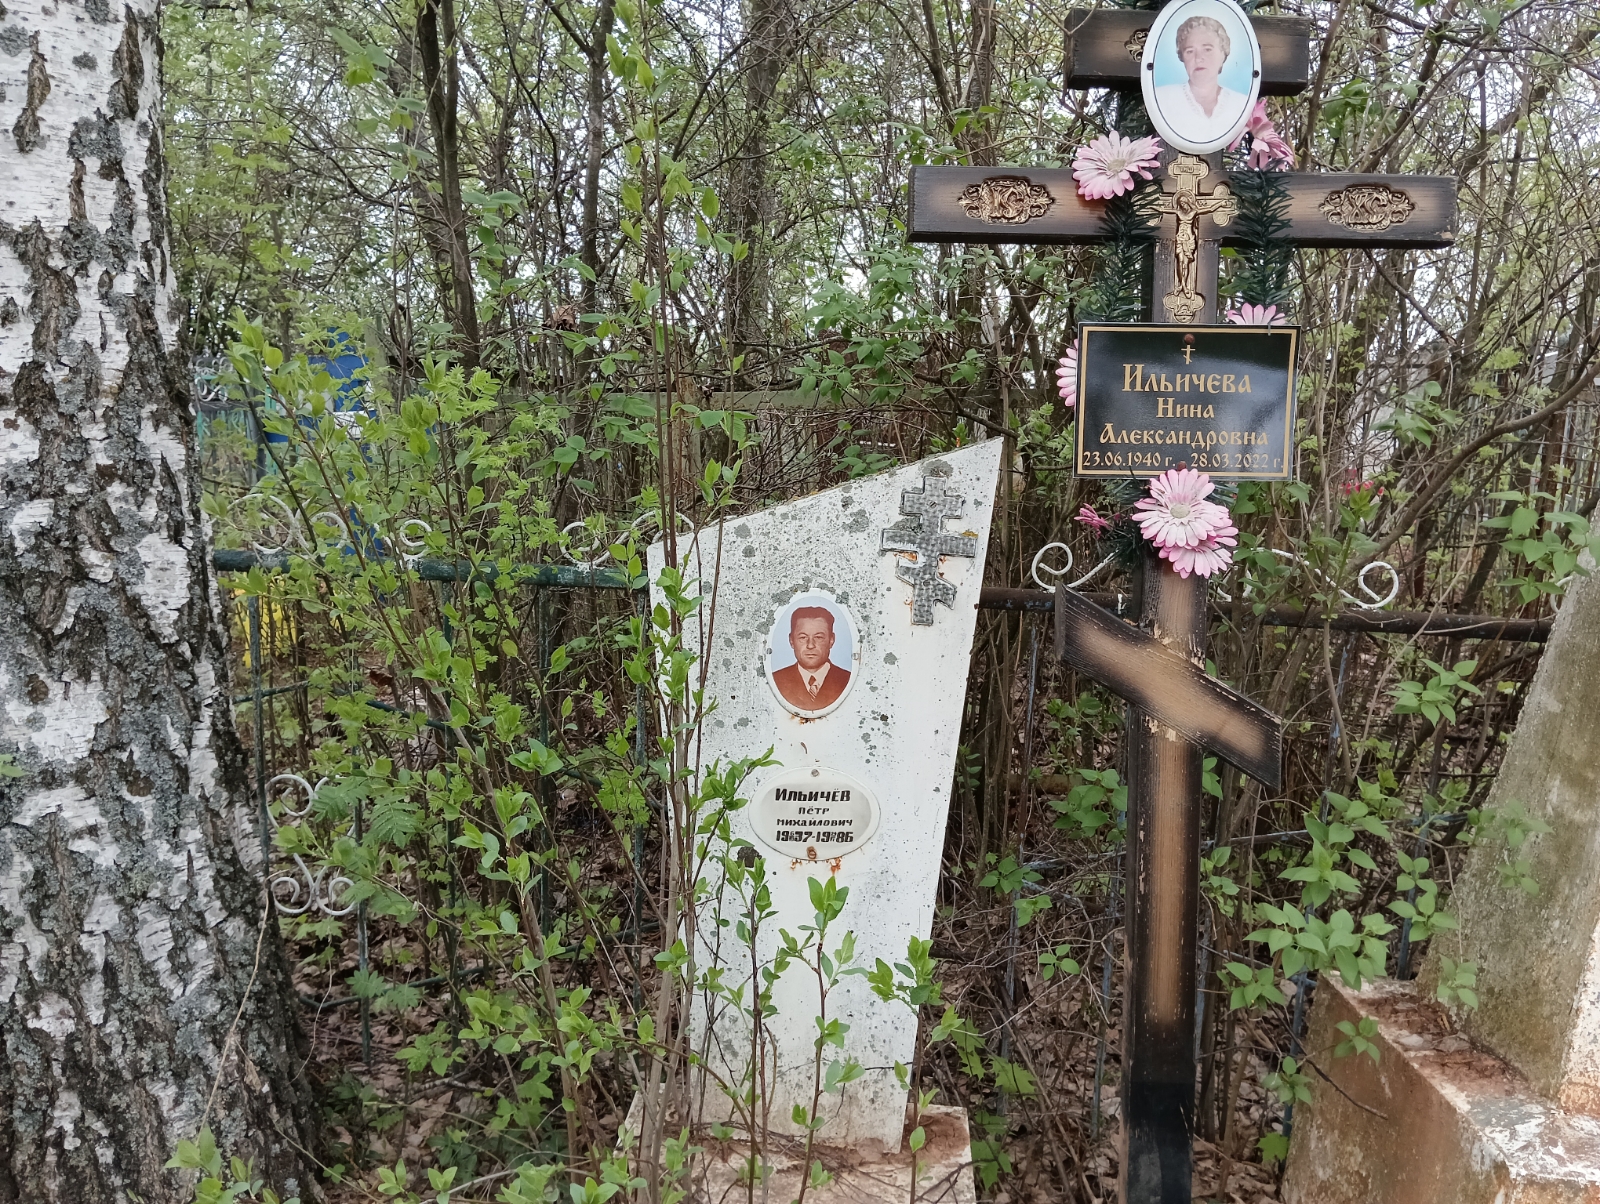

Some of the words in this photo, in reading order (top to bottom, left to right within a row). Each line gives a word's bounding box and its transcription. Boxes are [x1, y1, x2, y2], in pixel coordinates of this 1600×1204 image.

[1122, 363, 1252, 394] Ильичева
[1156, 397, 1215, 418] Нина
[1100, 423, 1269, 451] Александровна
[1083, 451, 1161, 467] 23.06.1940
[1165, 455, 1175, 467] г.
[1190, 452, 1268, 468] 28.03.2022
[1273, 458, 1284, 468] г.
